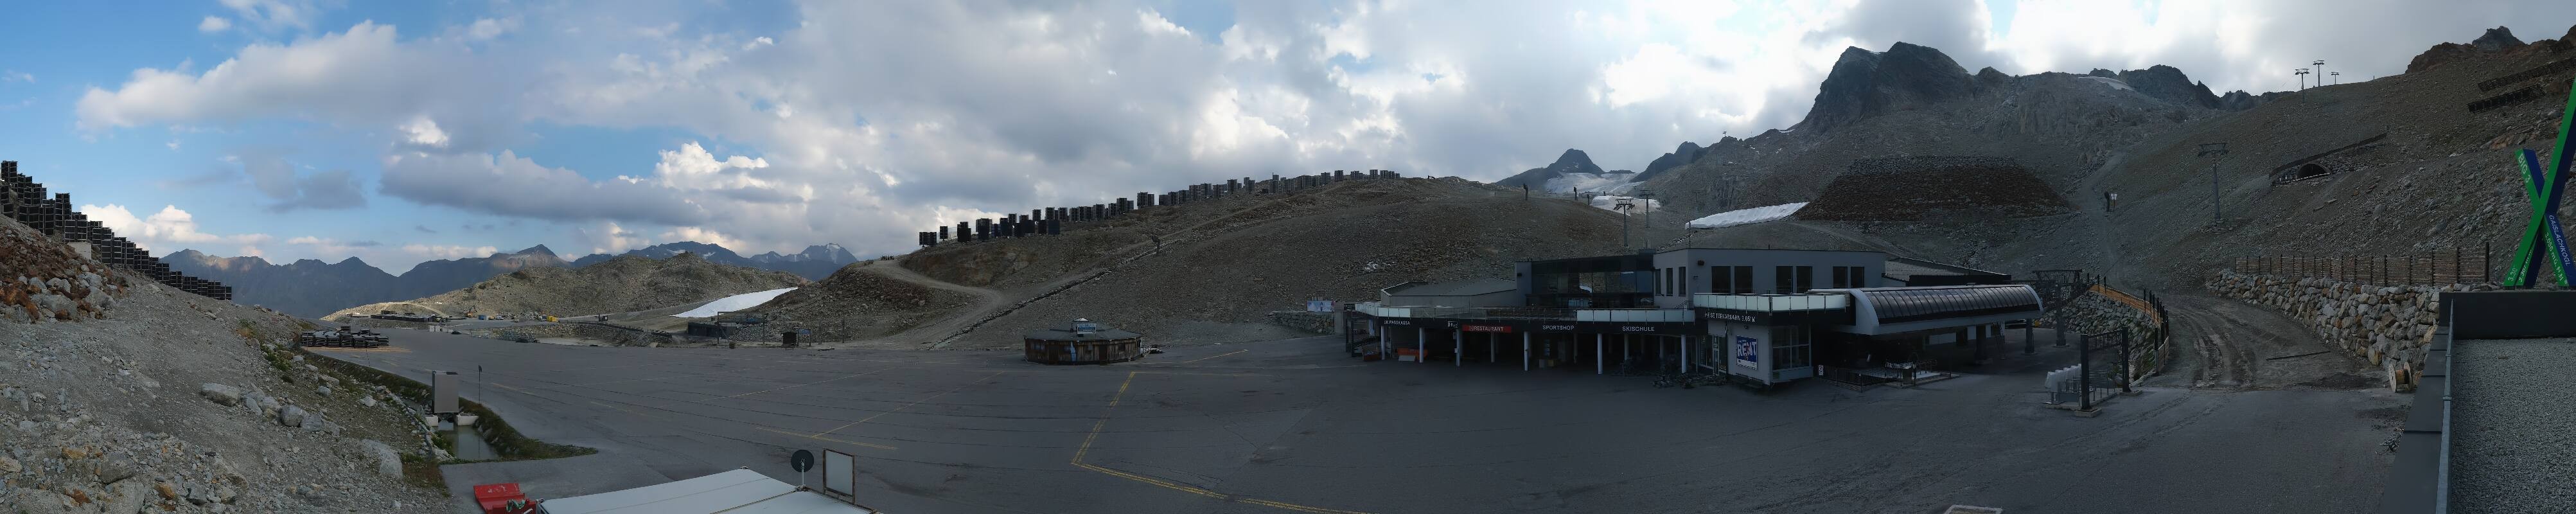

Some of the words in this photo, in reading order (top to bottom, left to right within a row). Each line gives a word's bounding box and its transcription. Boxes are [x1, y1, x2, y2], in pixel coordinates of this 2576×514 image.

[2518, 153, 2528, 174] BIG
[2525, 174, 2531, 183] 3
[2549, 215, 2571, 267] GAISLACHKOGL
